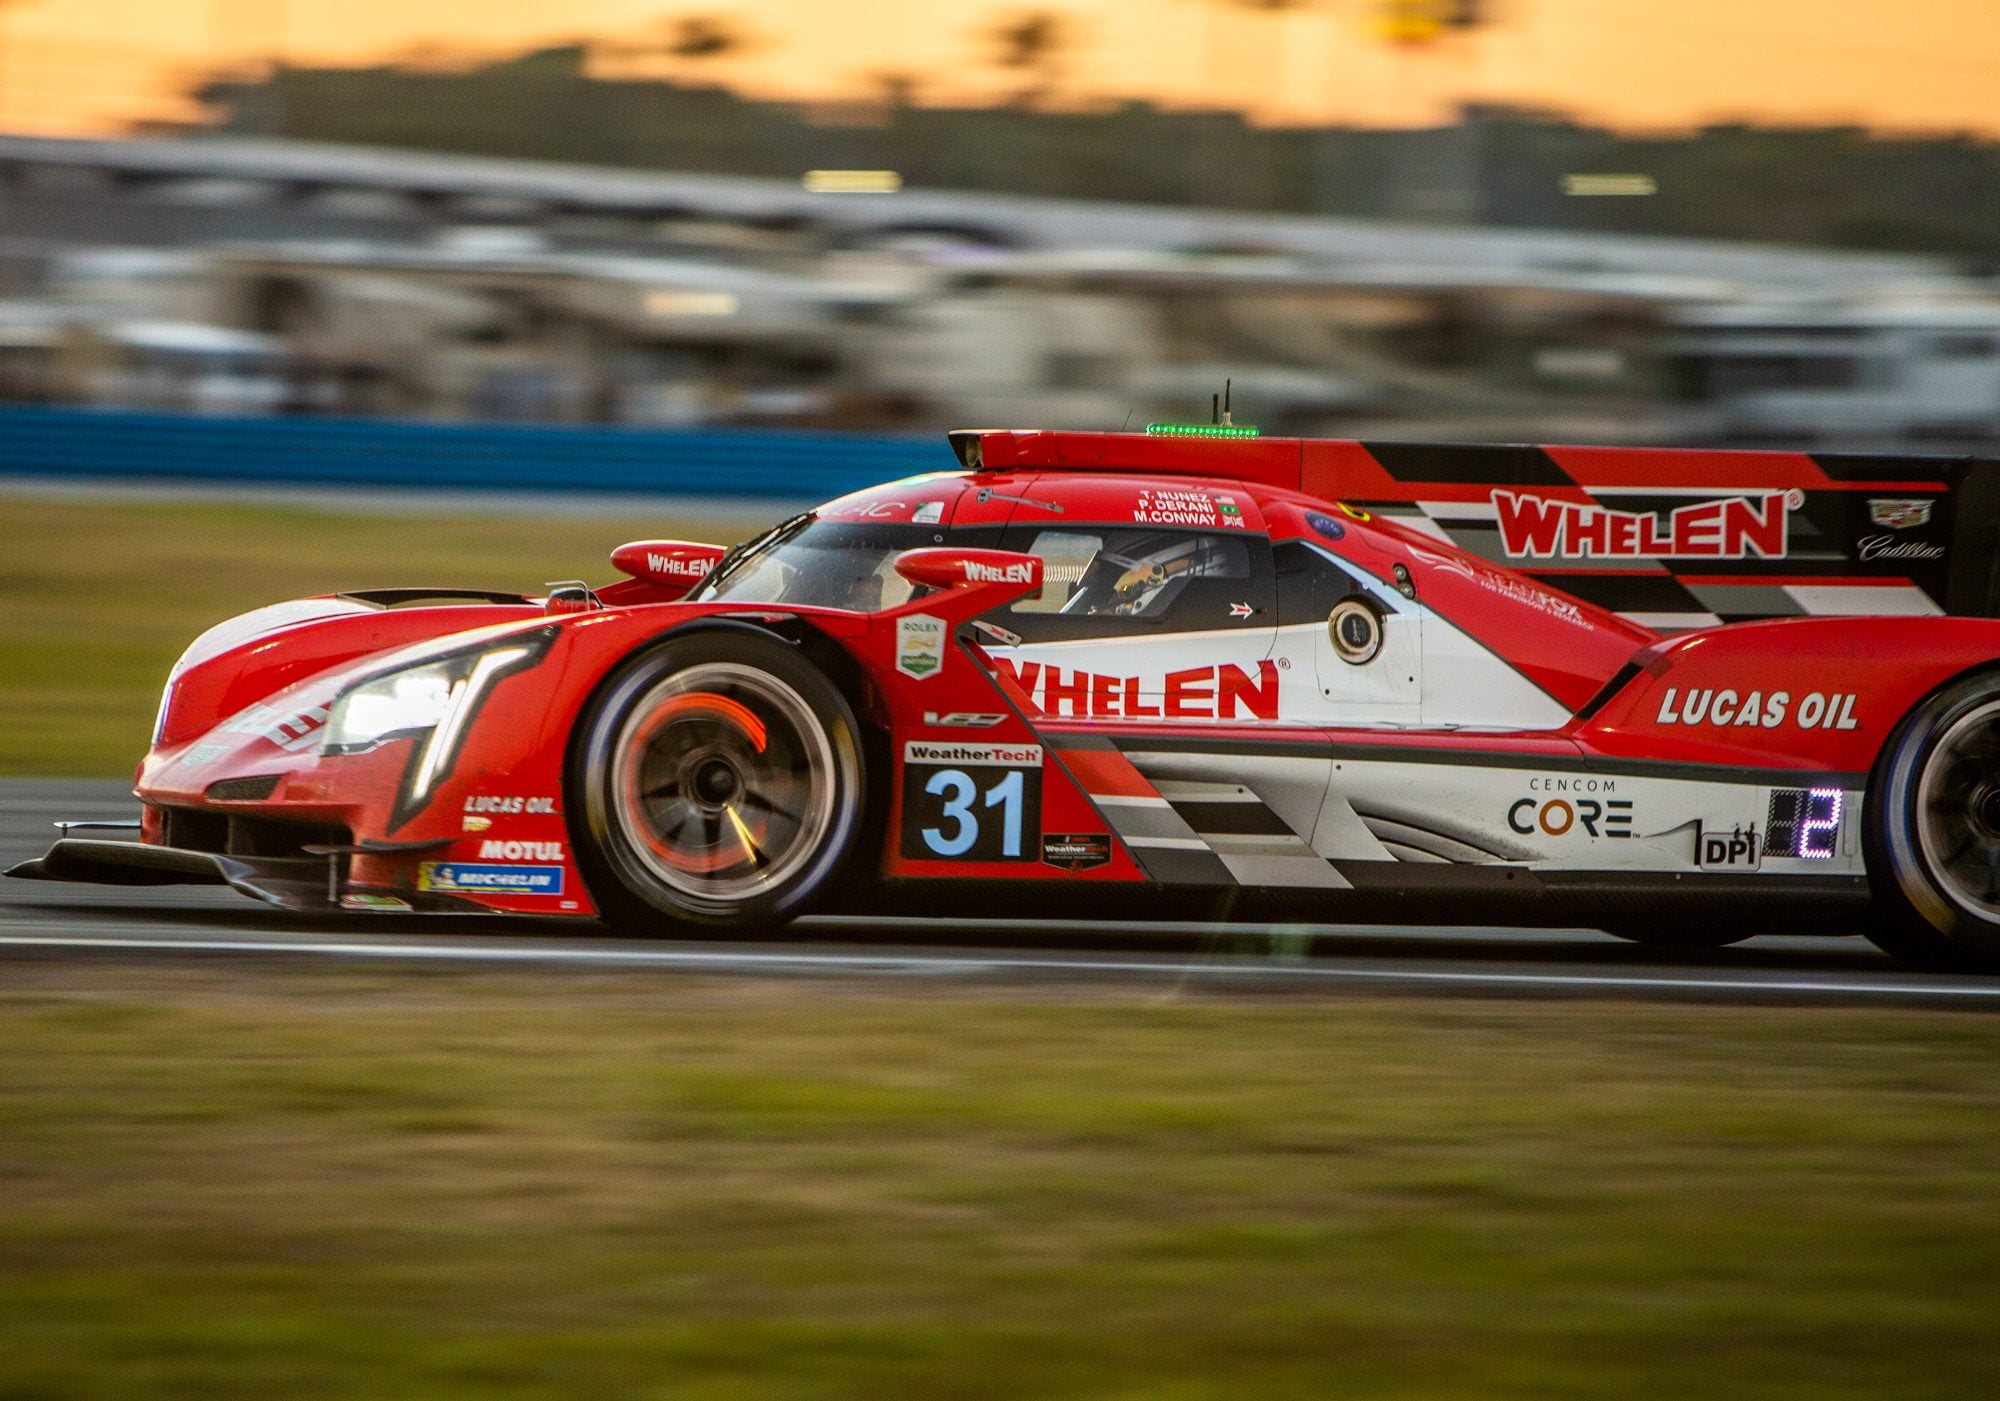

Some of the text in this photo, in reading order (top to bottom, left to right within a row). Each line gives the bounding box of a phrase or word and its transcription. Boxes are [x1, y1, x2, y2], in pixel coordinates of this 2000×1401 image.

[1139, 499, 1214, 513] P. DERANI
[1491, 489, 1787, 558] WHELEN
[1857, 535, 1946, 561] Cadillac
[647, 552, 715, 576] WHELEN
[962, 560, 1033, 584] WHELEN
[904, 622, 940, 633] ROLEX
[1656, 688, 1859, 730] LUCAS OIL
[910, 745, 1037, 762] WeatherTech
[1530, 778, 1615, 792] CENCOM
[463, 796, 557, 813] LUCAS OIL
[922, 769, 1024, 857] 31
[1508, 798, 1633, 837] CORE
[479, 840, 565, 860] MOTUL
[457, 872, 552, 886] MICHELIN
